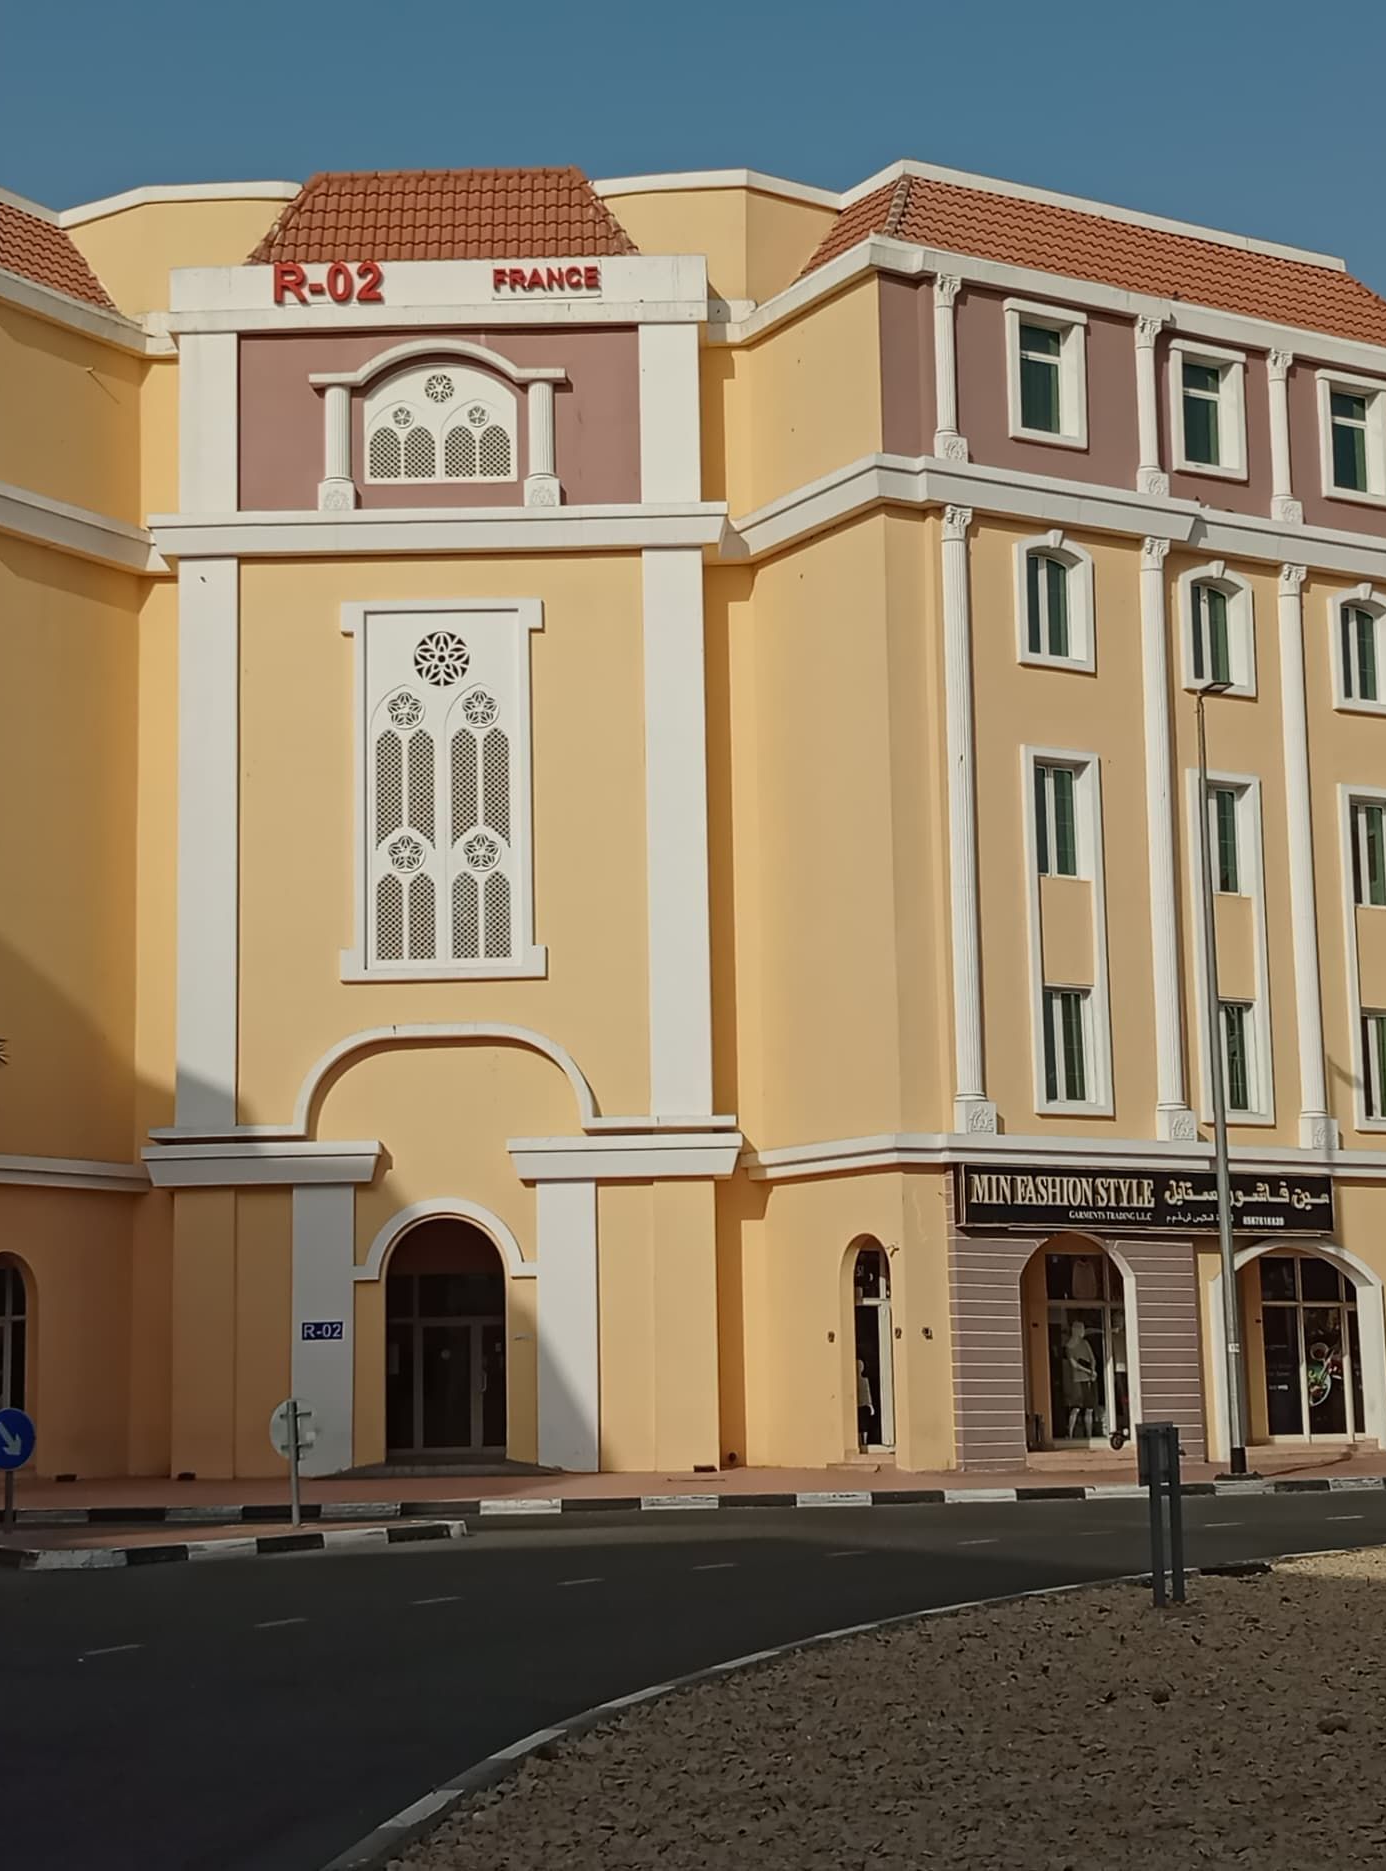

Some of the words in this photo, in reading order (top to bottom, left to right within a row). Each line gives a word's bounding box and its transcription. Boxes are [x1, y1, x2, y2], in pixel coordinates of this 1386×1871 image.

[273, 262, 385, 304] R-02
[493, 265, 602, 292] FRANCE
[970, 1173, 1011, 1204] MIN
[1013, 1175, 1093, 1207] FASHION
[1095, 1177, 1155, 1208] STYLE
[1069, 1209, 1105, 1220] GARMENTS
[1106, 1210, 1135, 1221] TRADING
[304, 1324, 341, 1338] R-02
